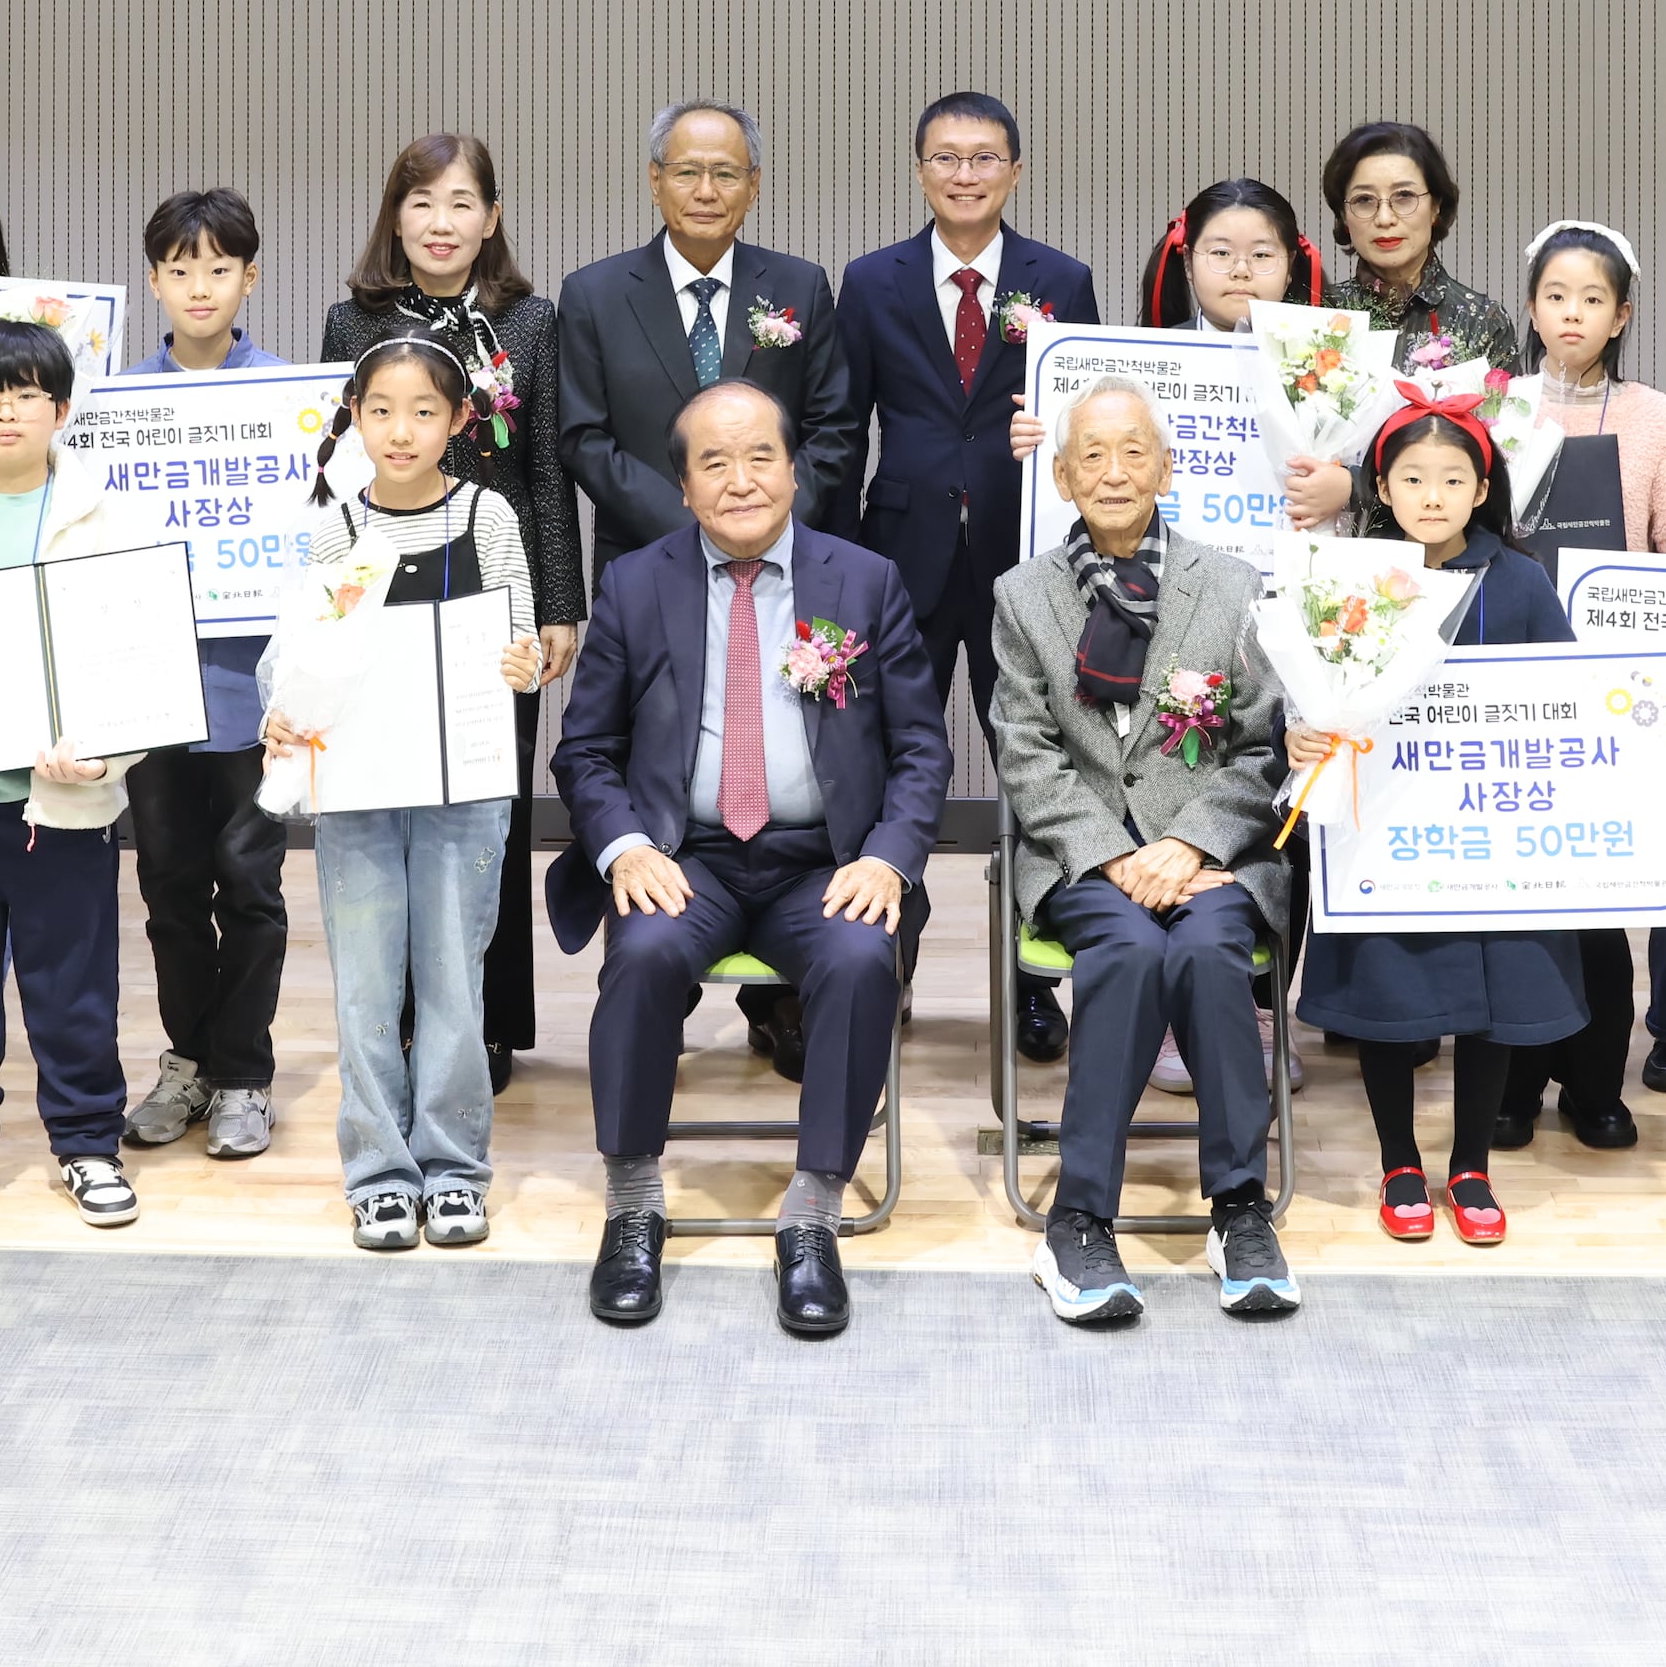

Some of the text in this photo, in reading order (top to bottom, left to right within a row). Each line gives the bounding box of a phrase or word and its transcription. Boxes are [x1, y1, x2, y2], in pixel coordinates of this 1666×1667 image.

[1053, 356, 1182, 376] 국립새만금간척박물관
[1193, 384, 1240, 403] 글짓기
[70, 407, 175, 428] 새만금간척박물관
[64, 421, 273, 450] 4회 전국 어린이 글짓기 대회
[104, 452, 311, 492] 새만금개발공사
[165, 495, 254, 529] 사장상
[1586, 609, 1636, 630] 제4회
[1427, 703, 1477, 724] 어린이
[1484, 702, 1537, 722] 글짓기
[1543, 701, 1577, 721] 대회
[1391, 736, 1620, 772] 새만금개발공사
[1458, 780, 1556, 813] 사장상
[1387, 820, 1635, 861] 장학금 50만원
